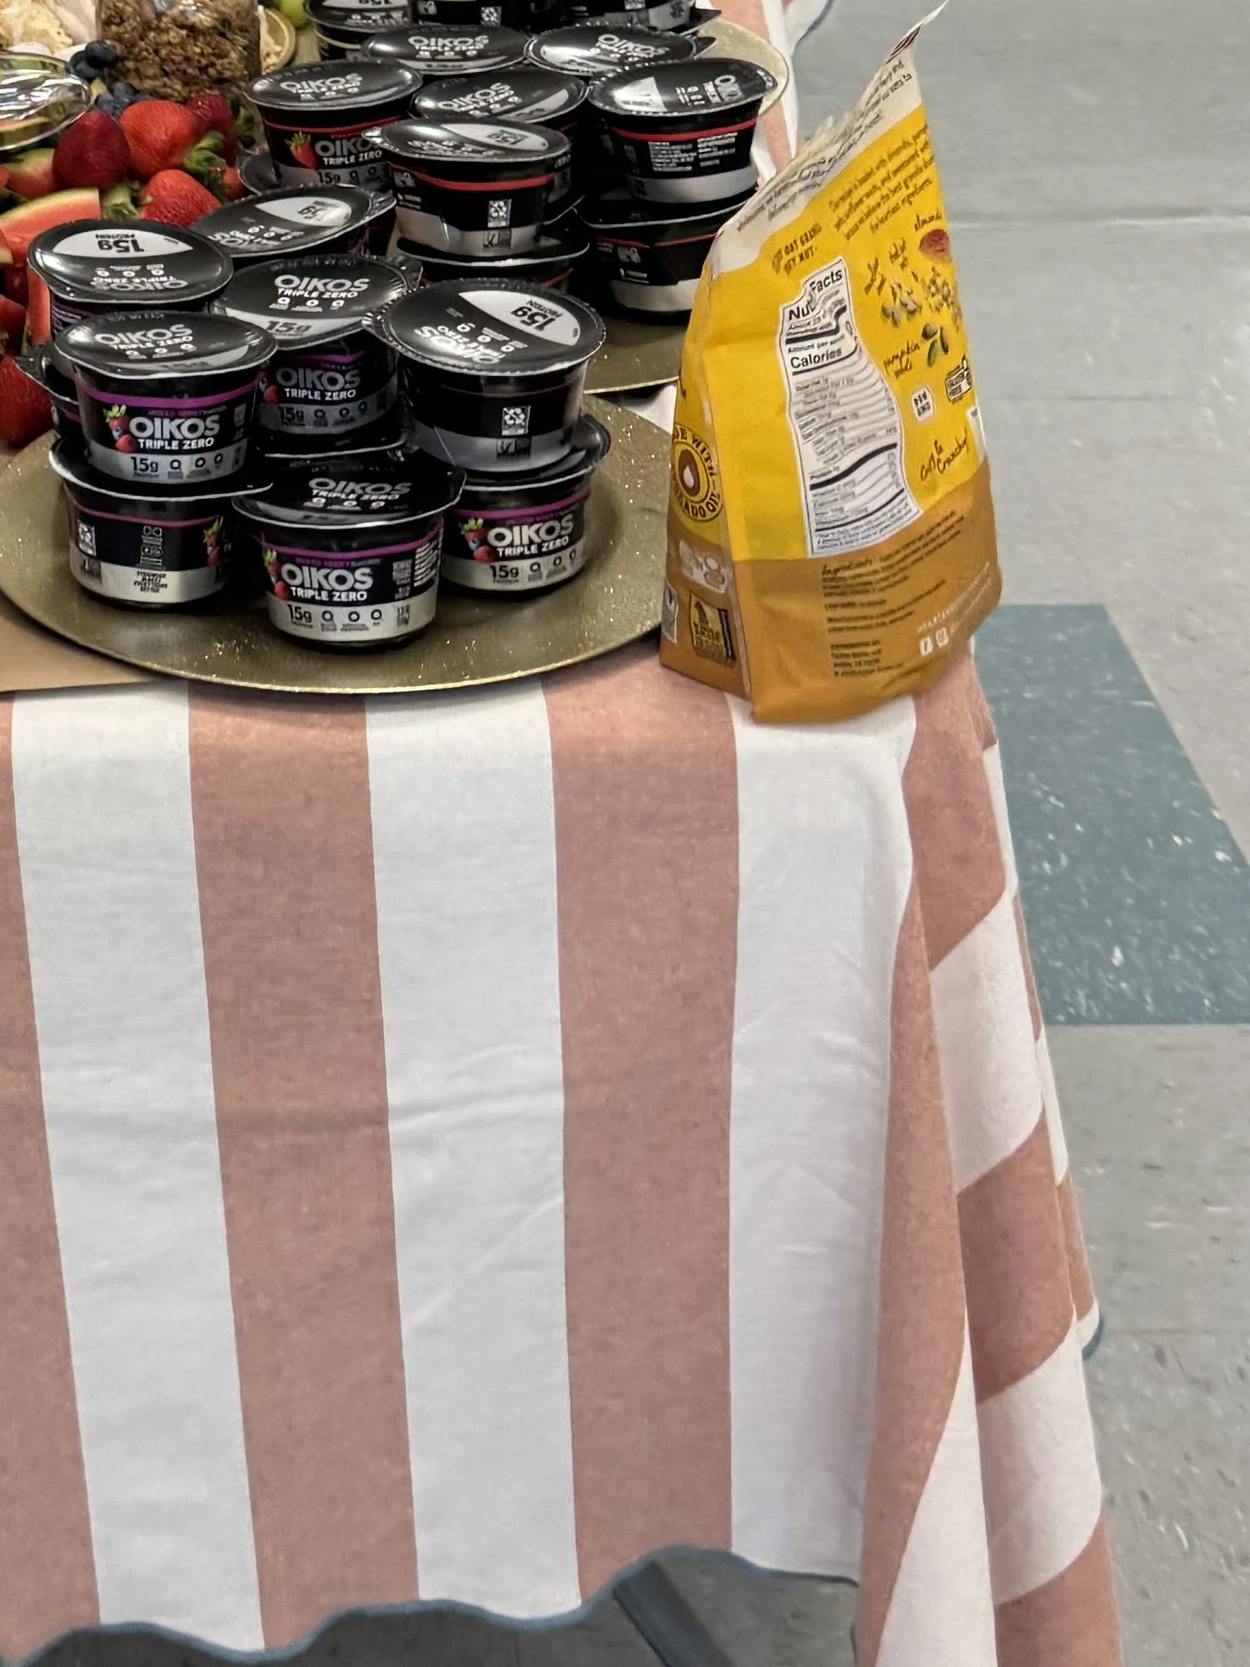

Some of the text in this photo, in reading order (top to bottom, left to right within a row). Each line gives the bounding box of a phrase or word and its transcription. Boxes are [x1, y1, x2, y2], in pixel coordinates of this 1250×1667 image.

[323, 150, 382, 166] TRIPLE ZERO
[97, 239, 144, 253] 15g
[274, 274, 370, 292] OIKOS
[809, 269, 842, 294] Facts
[277, 288, 320, 298] TRIPLE
[510, 306, 557, 332] 15g
[95, 324, 193, 345] OIKOS
[112, 335, 193, 350] TRIPLE ZERO
[790, 347, 842, 369] Calories
[275, 367, 361, 391] OIKOS
[284, 388, 357, 401] TRIPLE ZERO
[129, 414, 221, 439] OIKOS
[138, 437, 215, 450] TRIPLE ZERO
[130, 456, 159, 473] 15g
[308, 477, 412, 495] OIKOS
[312, 490, 400, 501] TRIPLE ZERO
[487, 513, 574, 547] OIKOS
[497, 536, 569, 557] TRIPLE ZERO
[280, 563, 374, 591] OIKOS
[490, 564, 519, 579] 15g
[290, 587, 368, 602] TRIPLE ZERO
[287, 604, 312, 623] 15g
